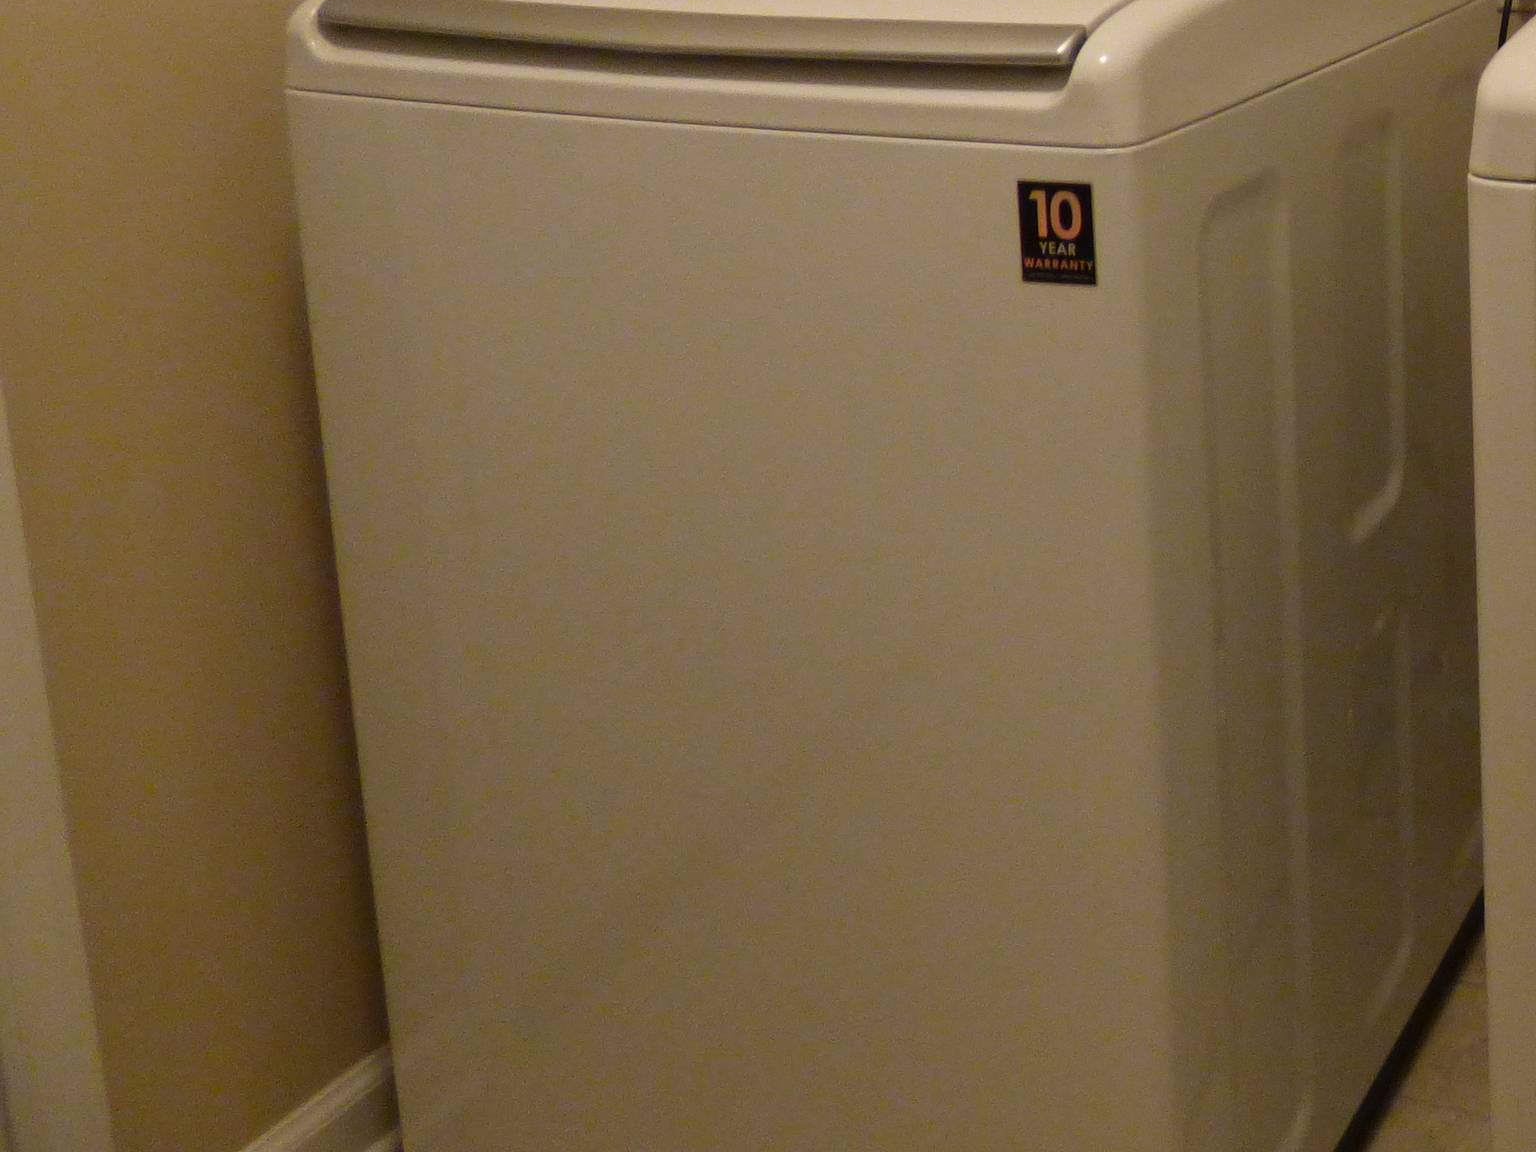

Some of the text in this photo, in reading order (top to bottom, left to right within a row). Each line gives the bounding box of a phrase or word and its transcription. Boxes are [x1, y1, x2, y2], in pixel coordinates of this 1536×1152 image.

[1029, 189, 1082, 240] 10
[1039, 241, 1076, 256] YEAR
[1024, 256, 1094, 270] WARRANTY
